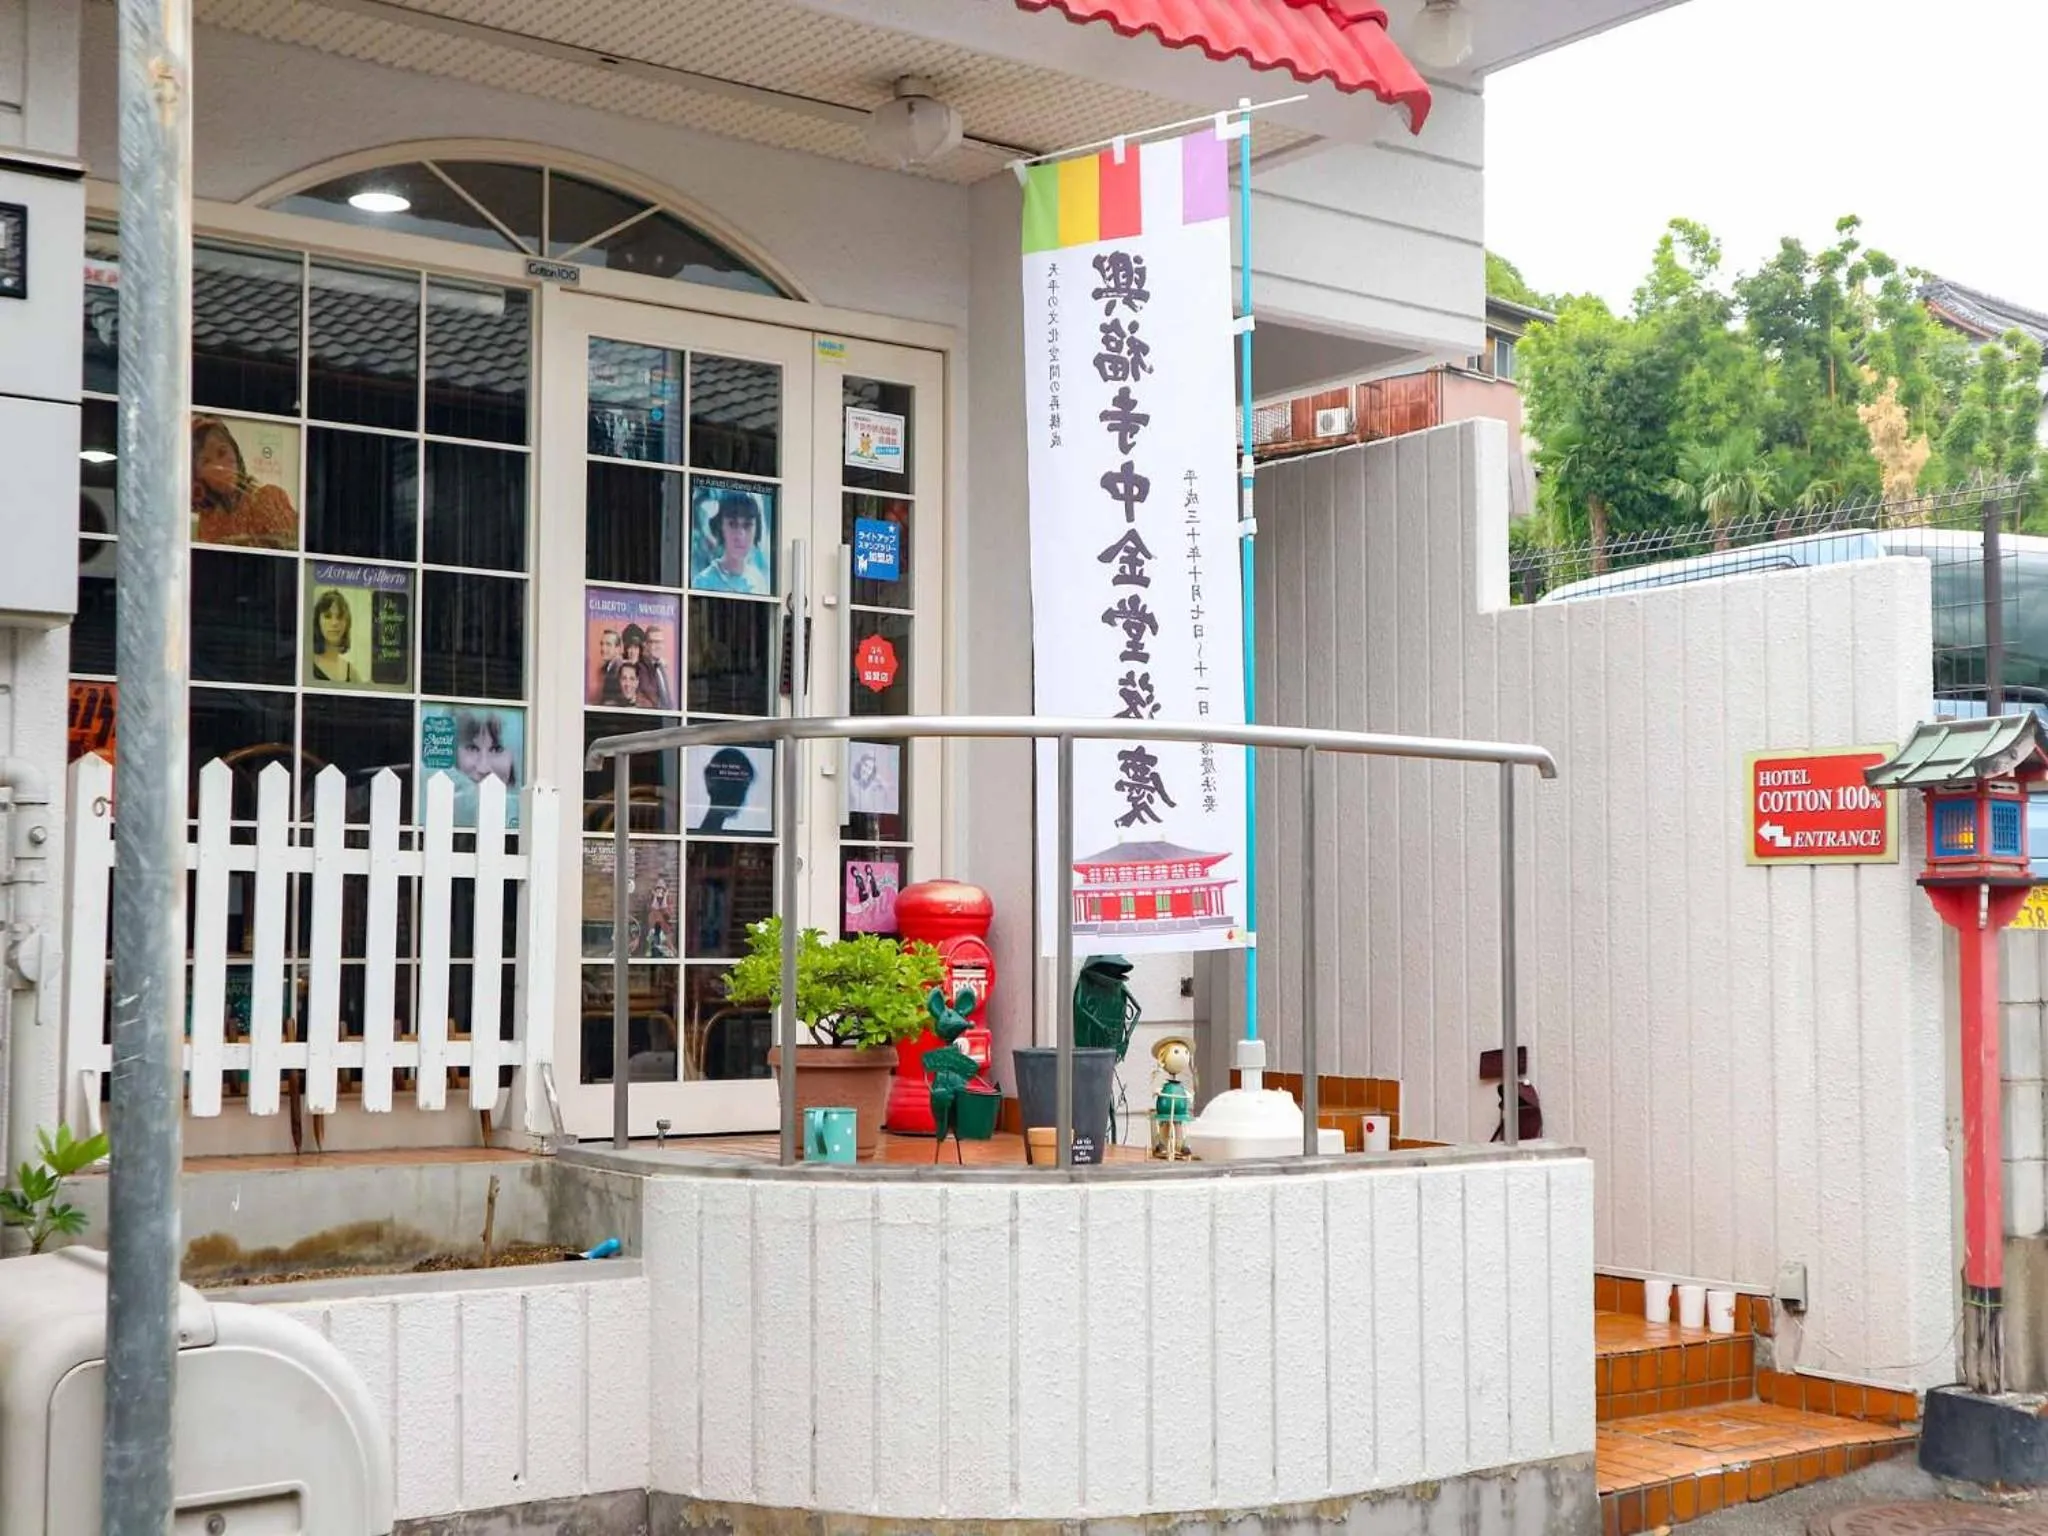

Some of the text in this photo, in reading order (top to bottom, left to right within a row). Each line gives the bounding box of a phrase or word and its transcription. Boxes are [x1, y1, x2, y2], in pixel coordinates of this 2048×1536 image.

[362, 567, 406, 586] Gilberto
[1759, 769, 1811, 786] HOTEL
[1759, 785, 1882, 813] COTTON 100%
[1793, 829, 1881, 848] ENTRANCE
